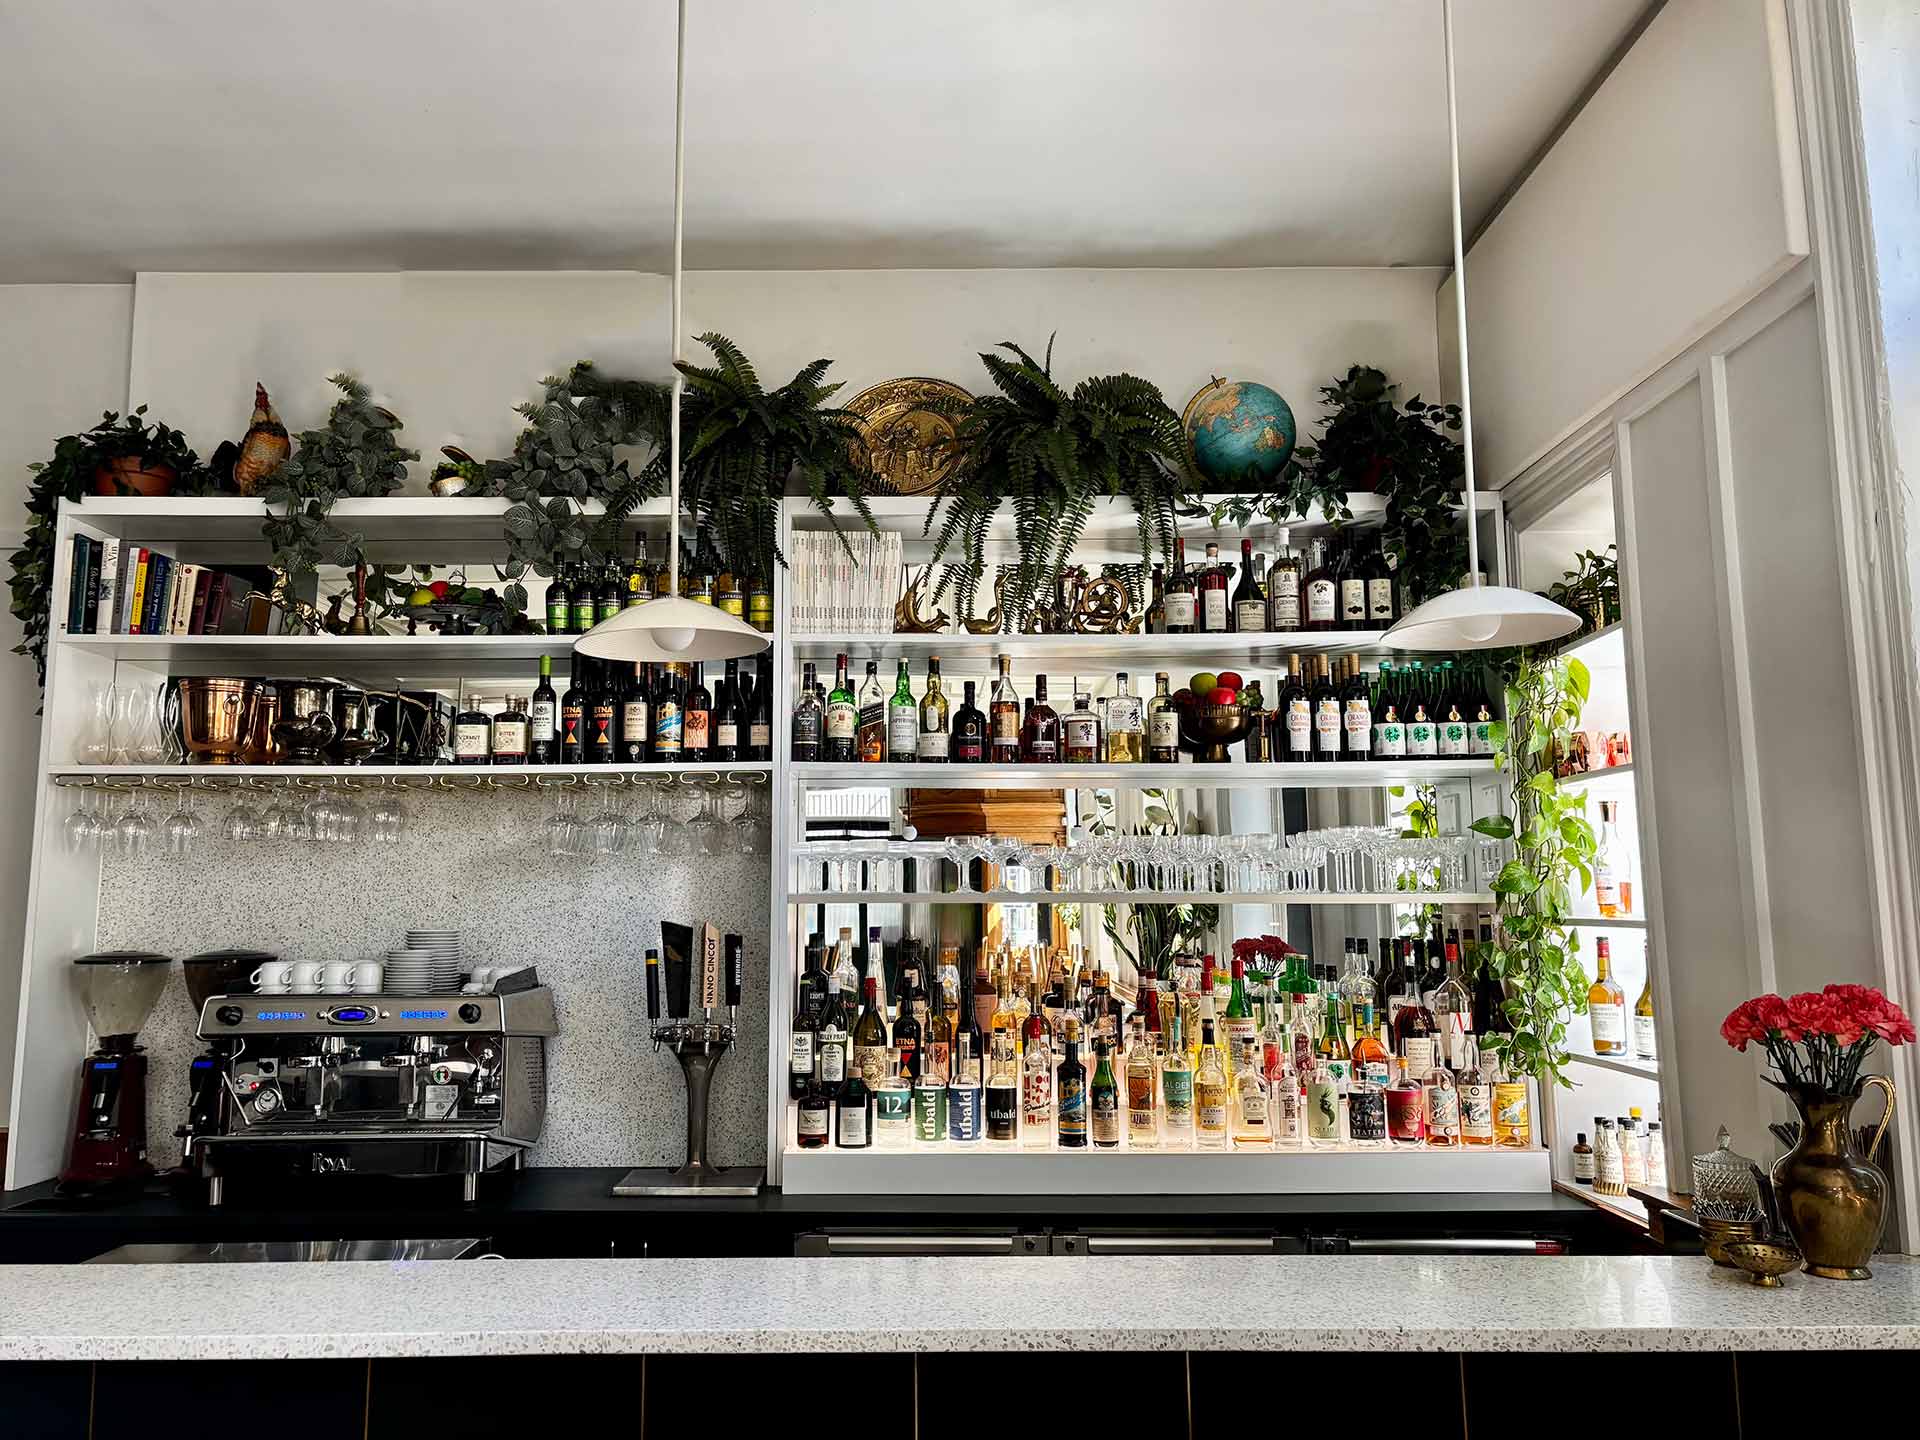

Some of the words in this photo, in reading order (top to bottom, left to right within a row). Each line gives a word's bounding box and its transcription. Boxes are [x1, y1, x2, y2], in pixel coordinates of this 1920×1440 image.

[828, 704, 855, 714] JAMESON
[706, 975, 714, 1003] NANO
[884, 1095, 903, 1113] 12
[990, 1108, 1016, 1119] ubald
[922, 1091, 936, 1139] ubald
[958, 1091, 972, 1139] ubald
[312, 1152, 356, 1173] ROYAL
